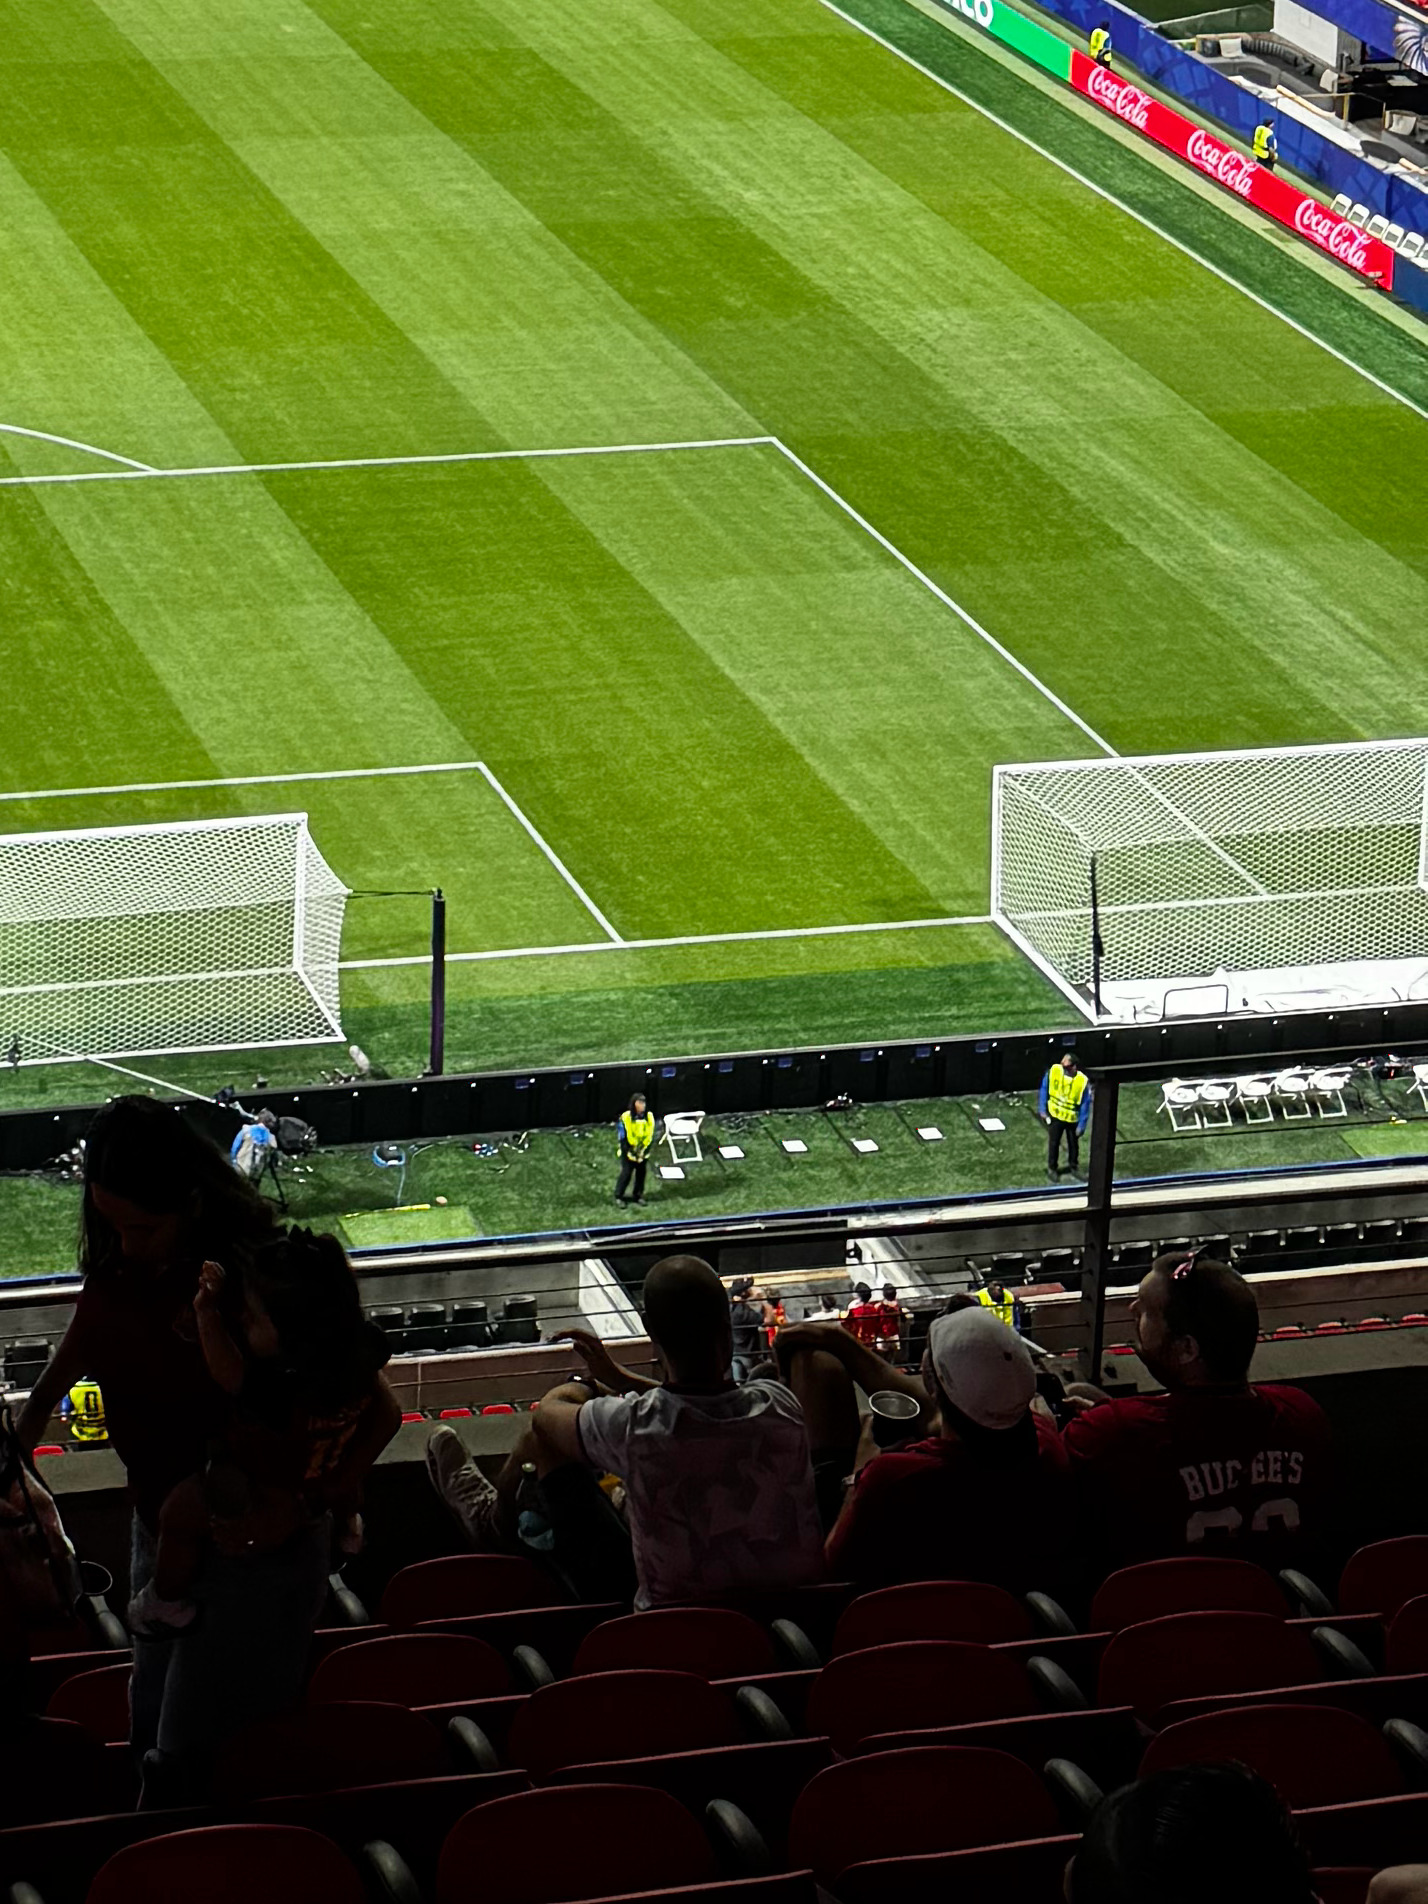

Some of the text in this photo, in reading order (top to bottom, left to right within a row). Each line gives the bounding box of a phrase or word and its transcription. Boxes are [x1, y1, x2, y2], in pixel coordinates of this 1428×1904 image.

[1087, 64, 1153, 131] Coca-Cola
[1187, 129, 1258, 197] Coca-Cola
[1294, 197, 1371, 273] Coca-Cola
